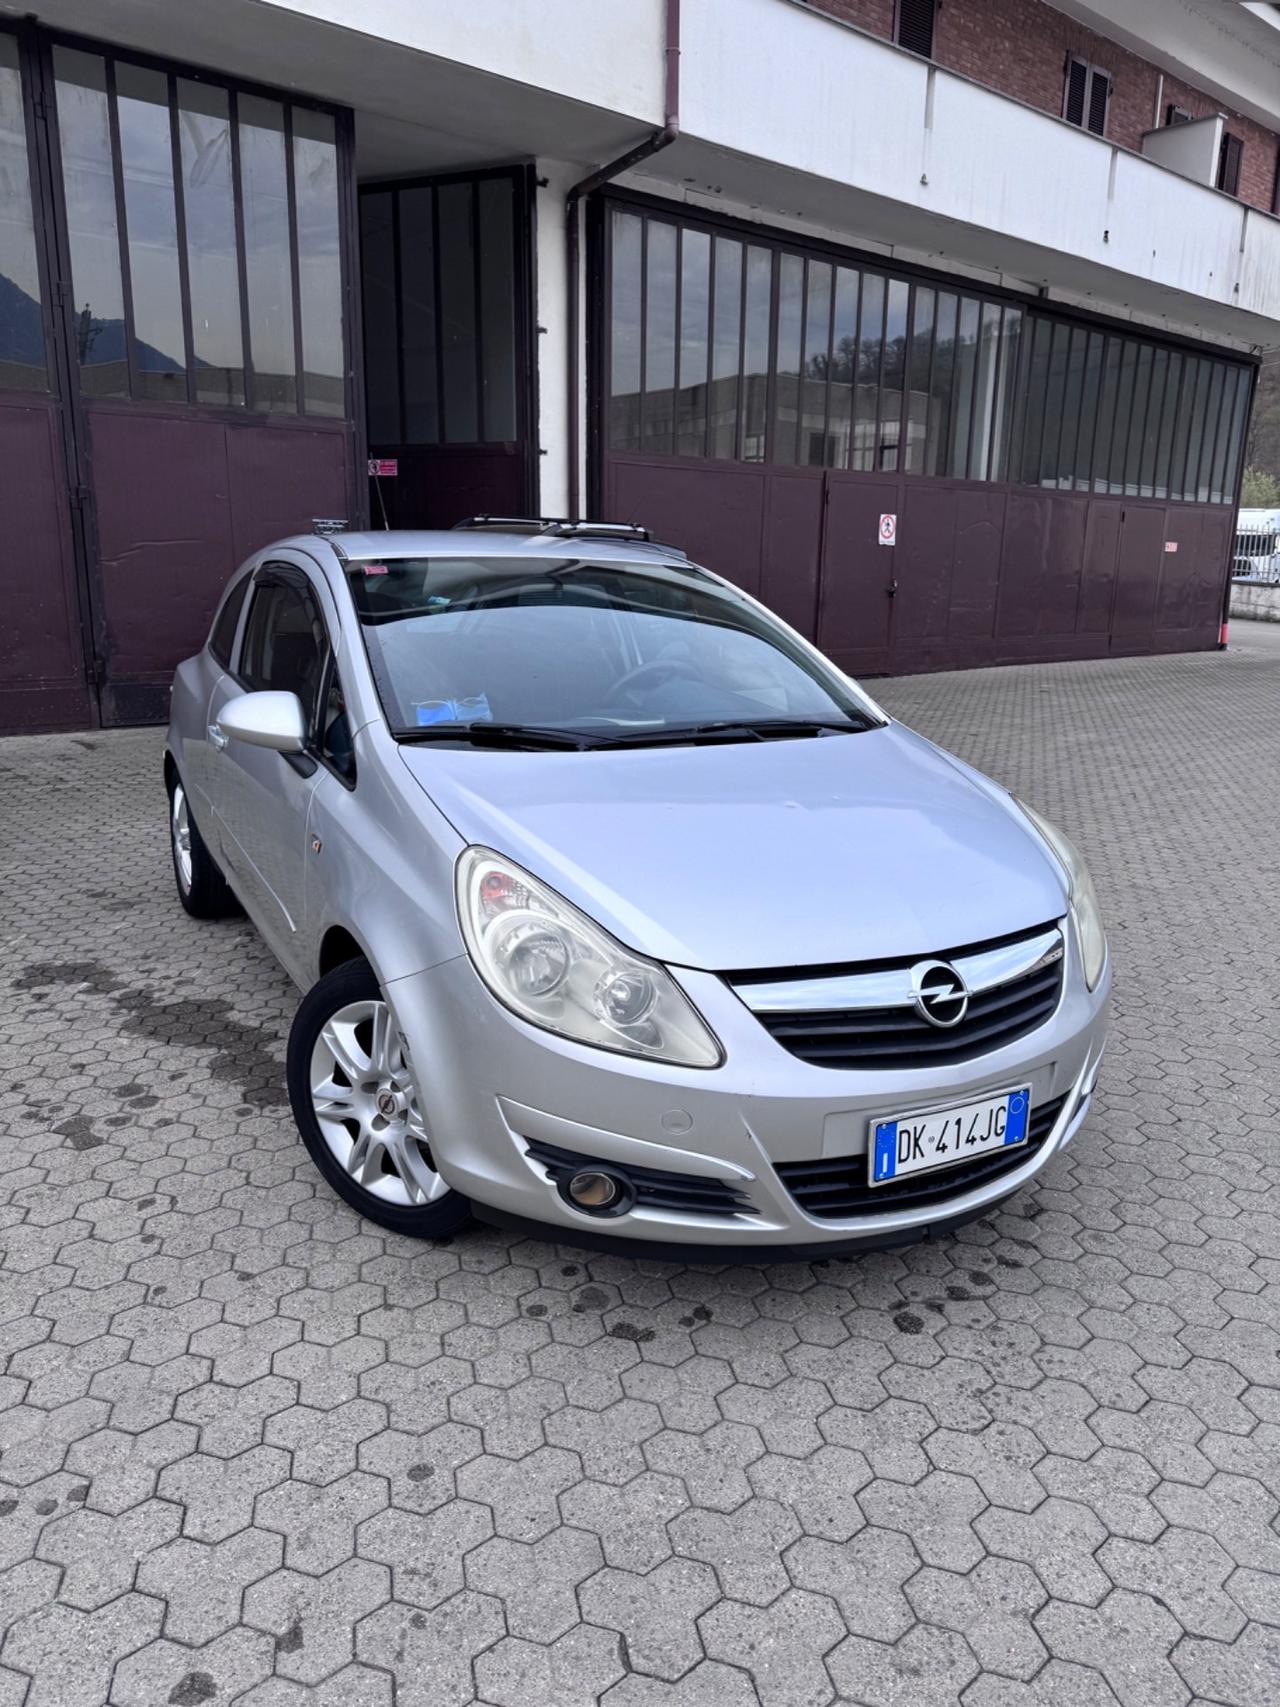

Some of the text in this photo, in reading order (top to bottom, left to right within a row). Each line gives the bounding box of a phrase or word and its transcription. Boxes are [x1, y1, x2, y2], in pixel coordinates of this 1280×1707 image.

[897, 1105, 1007, 1164] DK 414JG
[882, 1152, 889, 1173] I
